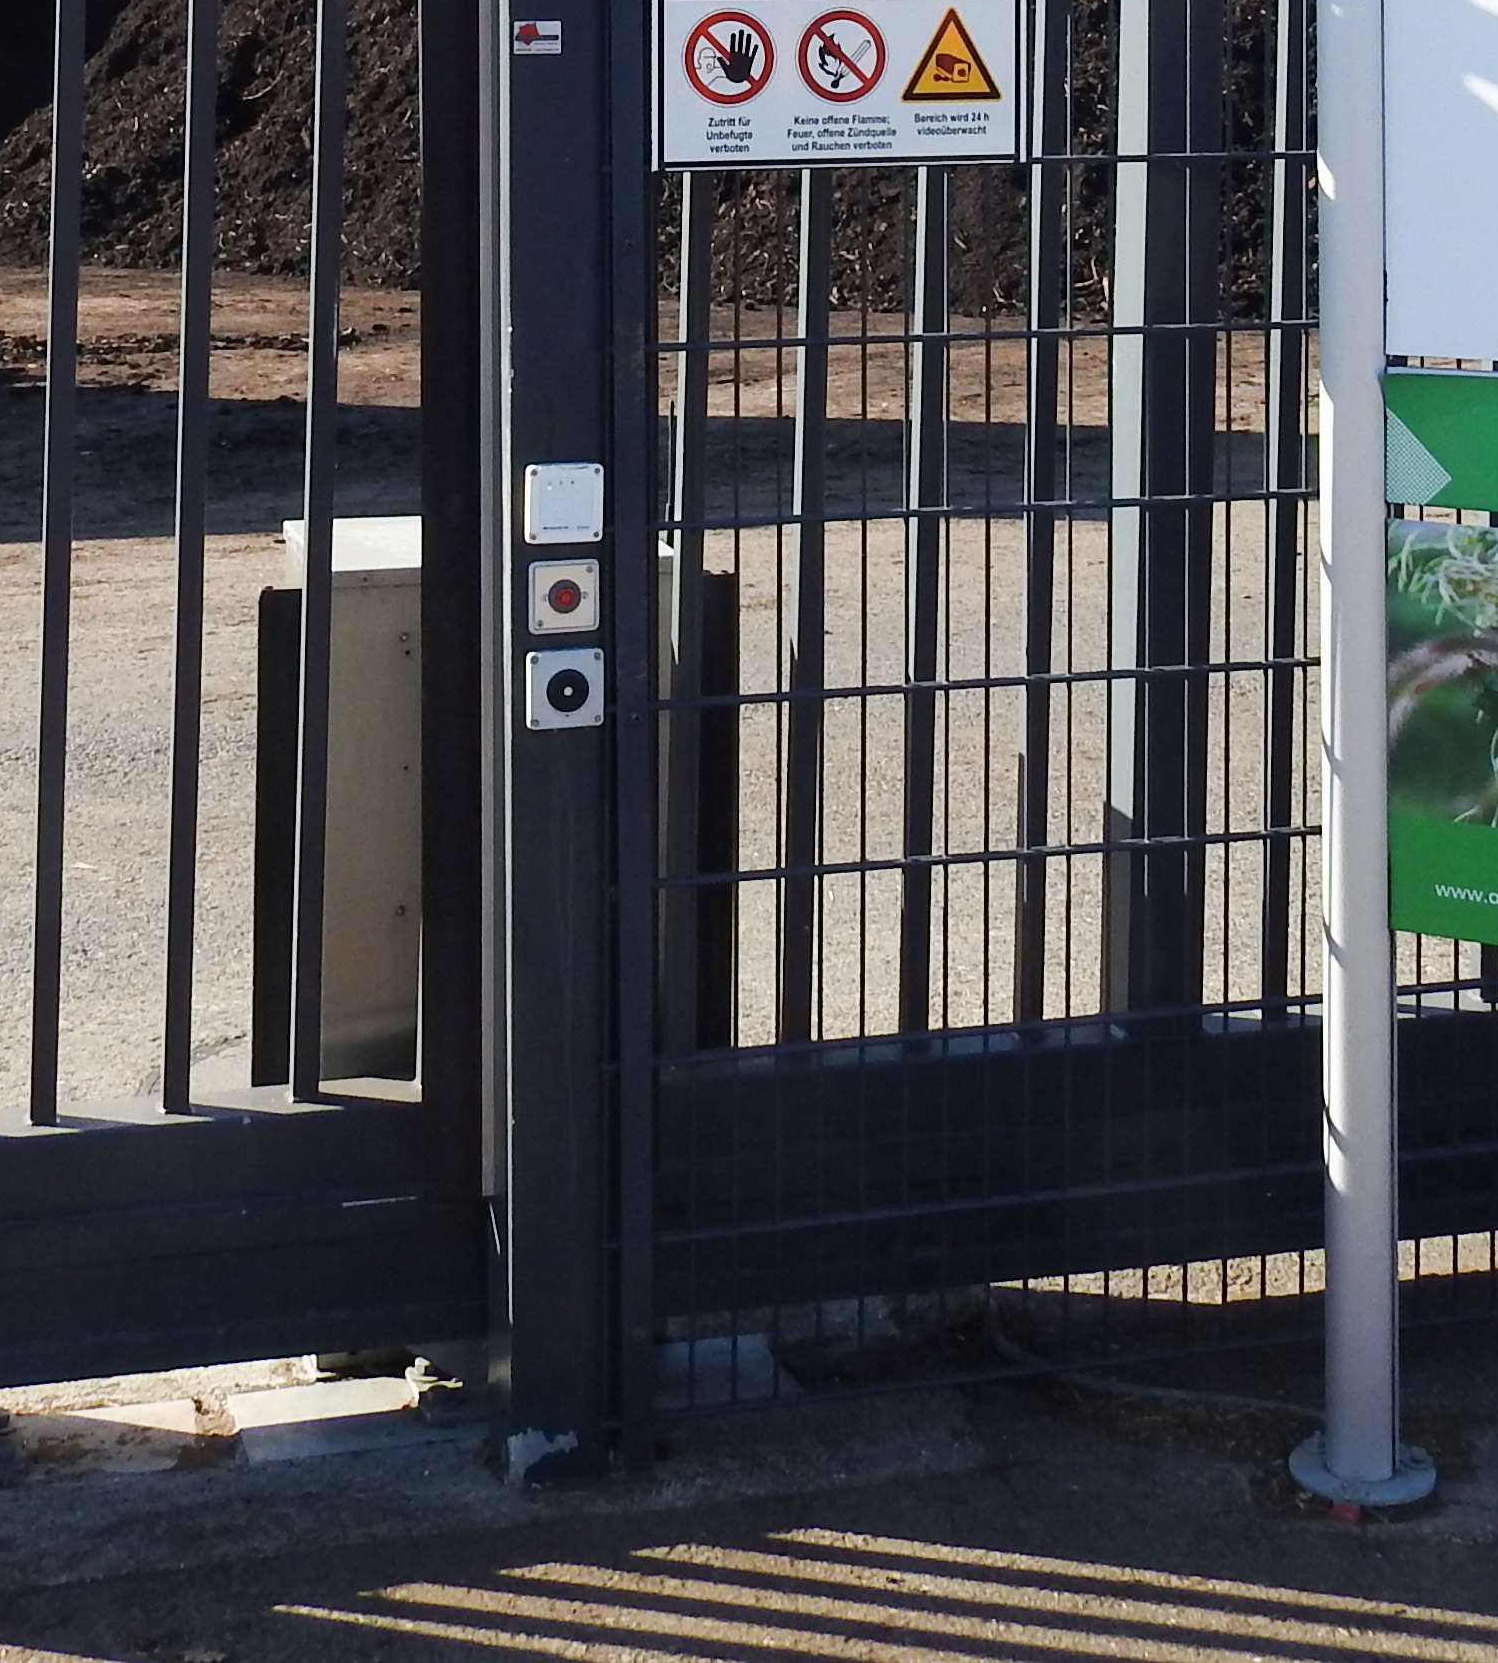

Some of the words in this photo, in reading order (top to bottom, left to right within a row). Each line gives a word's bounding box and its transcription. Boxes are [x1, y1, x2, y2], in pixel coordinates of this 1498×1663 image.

[971, 112, 981, 122] 24
[983, 112, 990, 122] h
[709, 143, 750, 153] verboten
[791, 142, 809, 151] und
